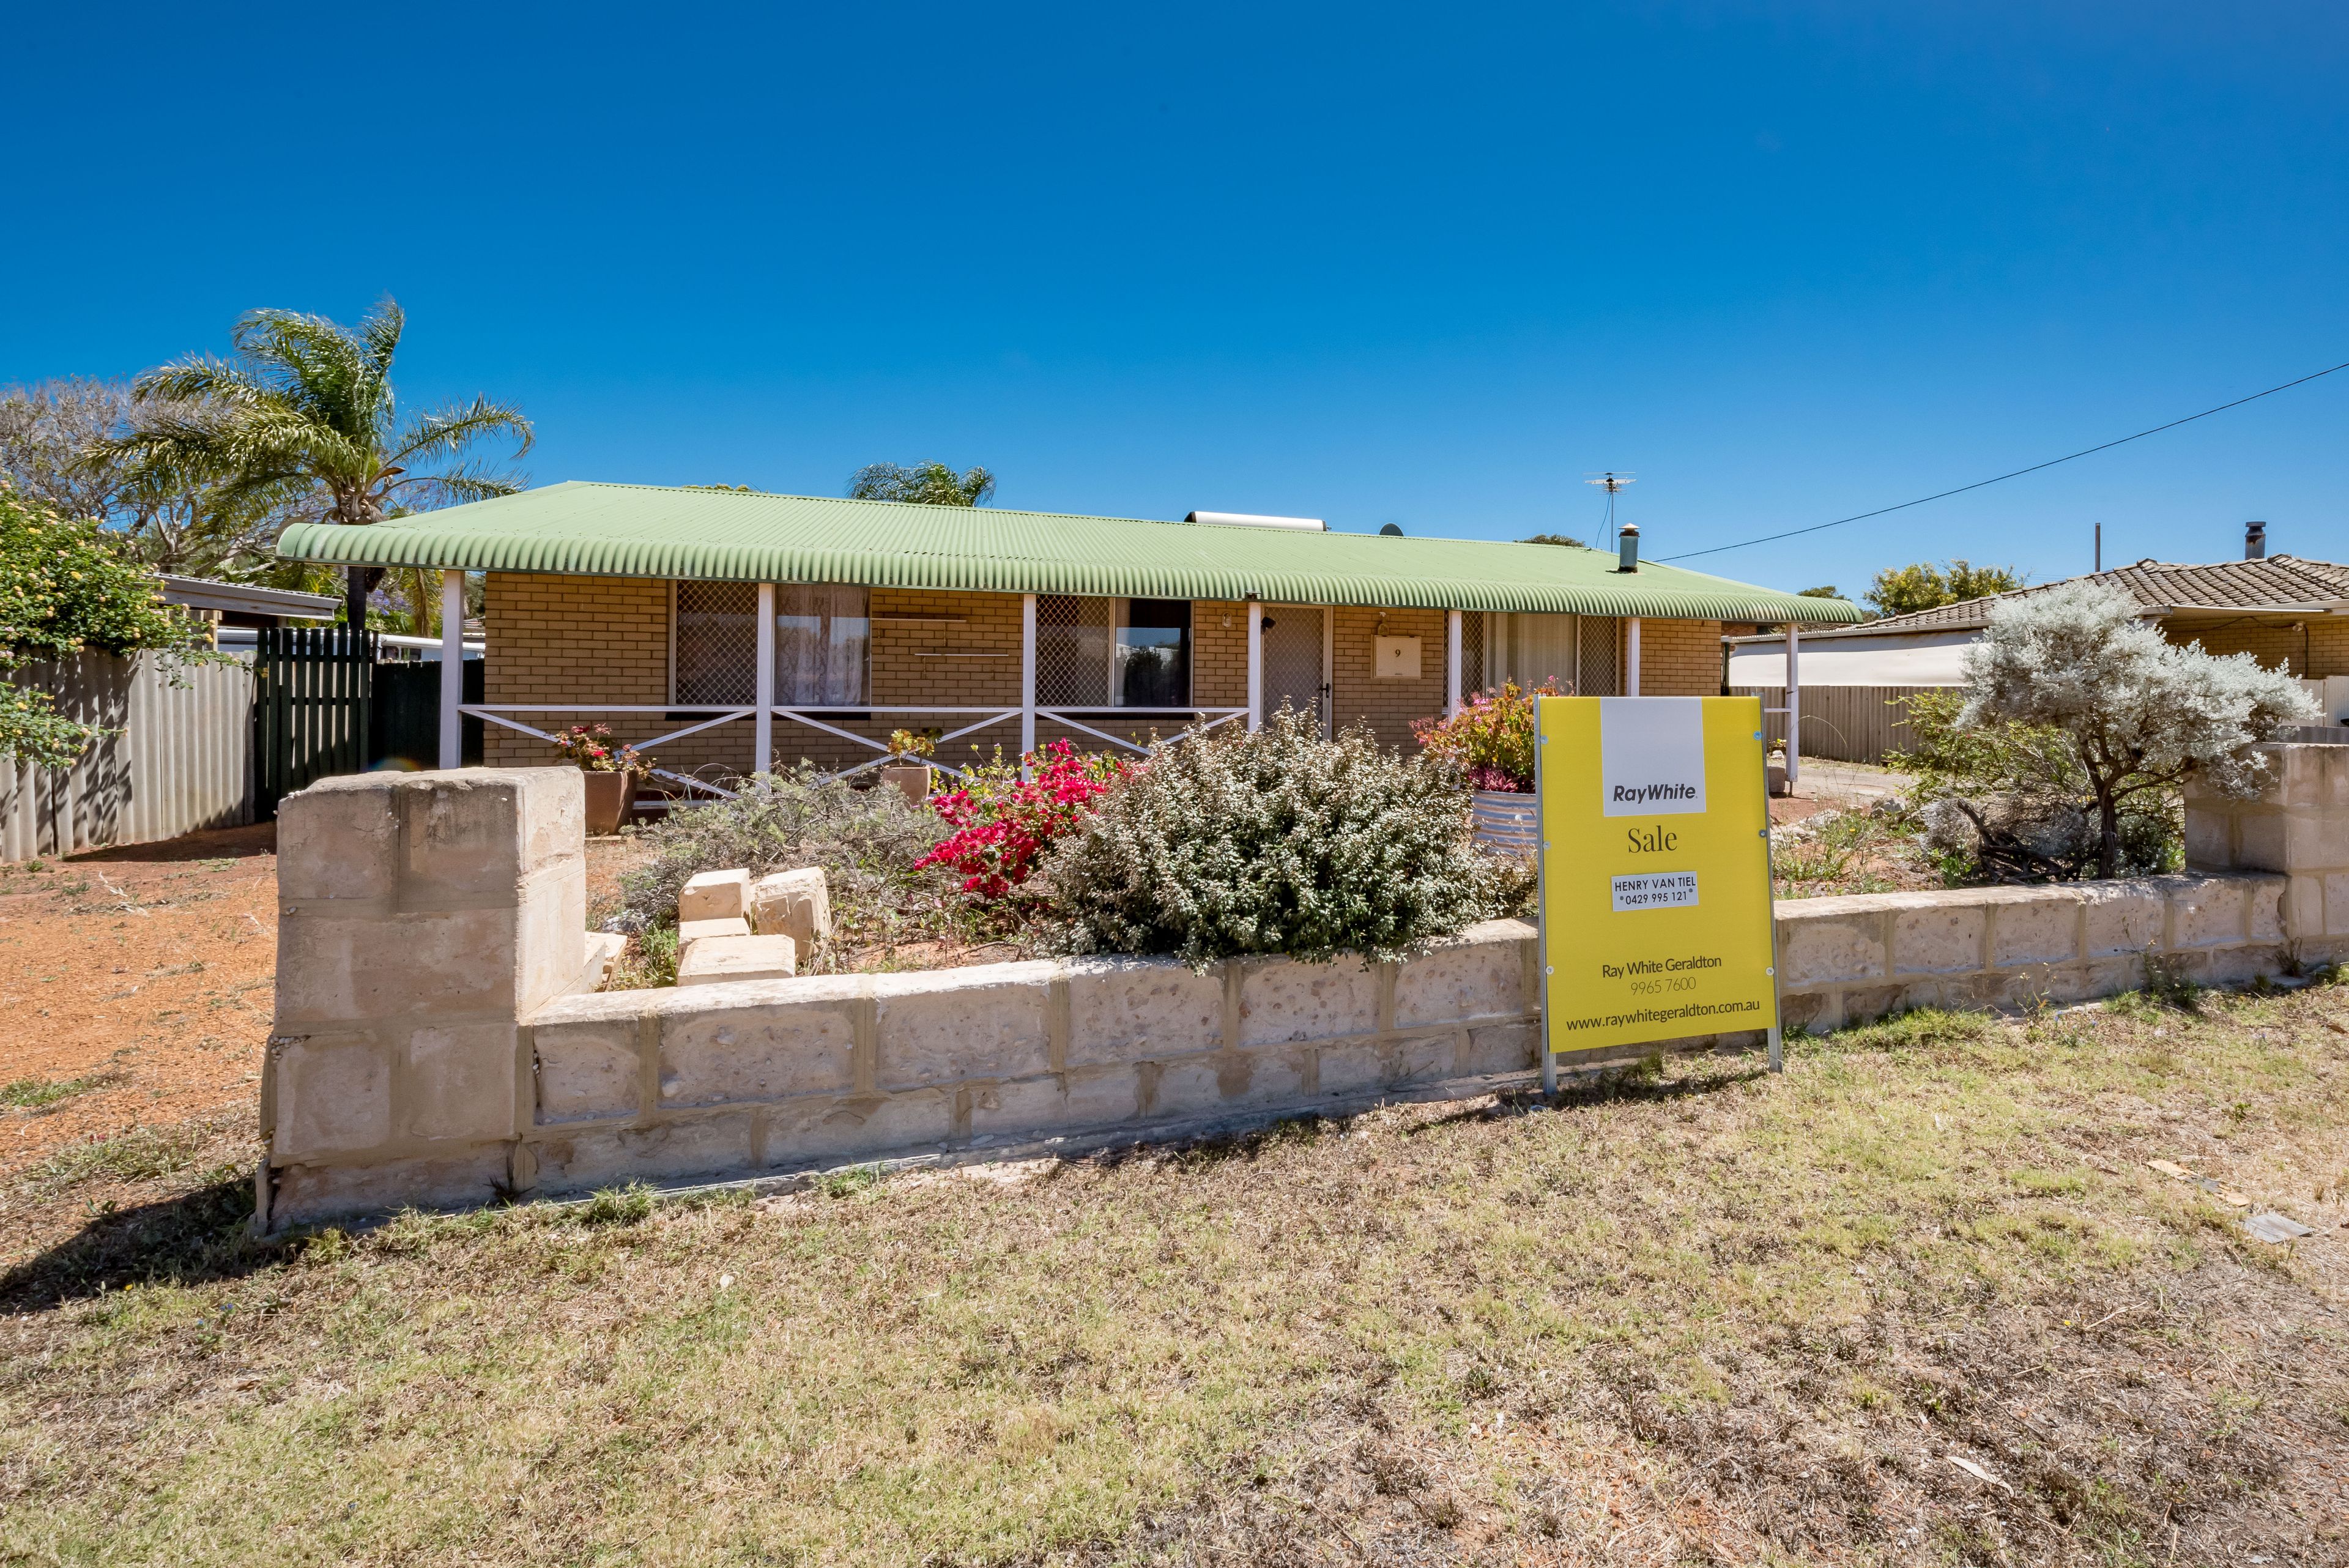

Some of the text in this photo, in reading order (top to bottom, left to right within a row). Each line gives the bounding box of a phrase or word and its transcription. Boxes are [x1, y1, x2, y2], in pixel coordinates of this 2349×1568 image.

[1395, 649, 1401, 658] 9
[1613, 784, 1696, 804] RayWhite
[1628, 825, 1678, 853] Sale
[1615, 877, 1696, 891] HENRY VAN TIEL
[1625, 891, 1687, 905] 0429 995 121
[1602, 956, 1722, 979] Ray White Geraldton
[1631, 976, 1696, 995] 9965 7600
[1566, 1000, 1760, 1031] www.raywhitegeraldton.com.au
